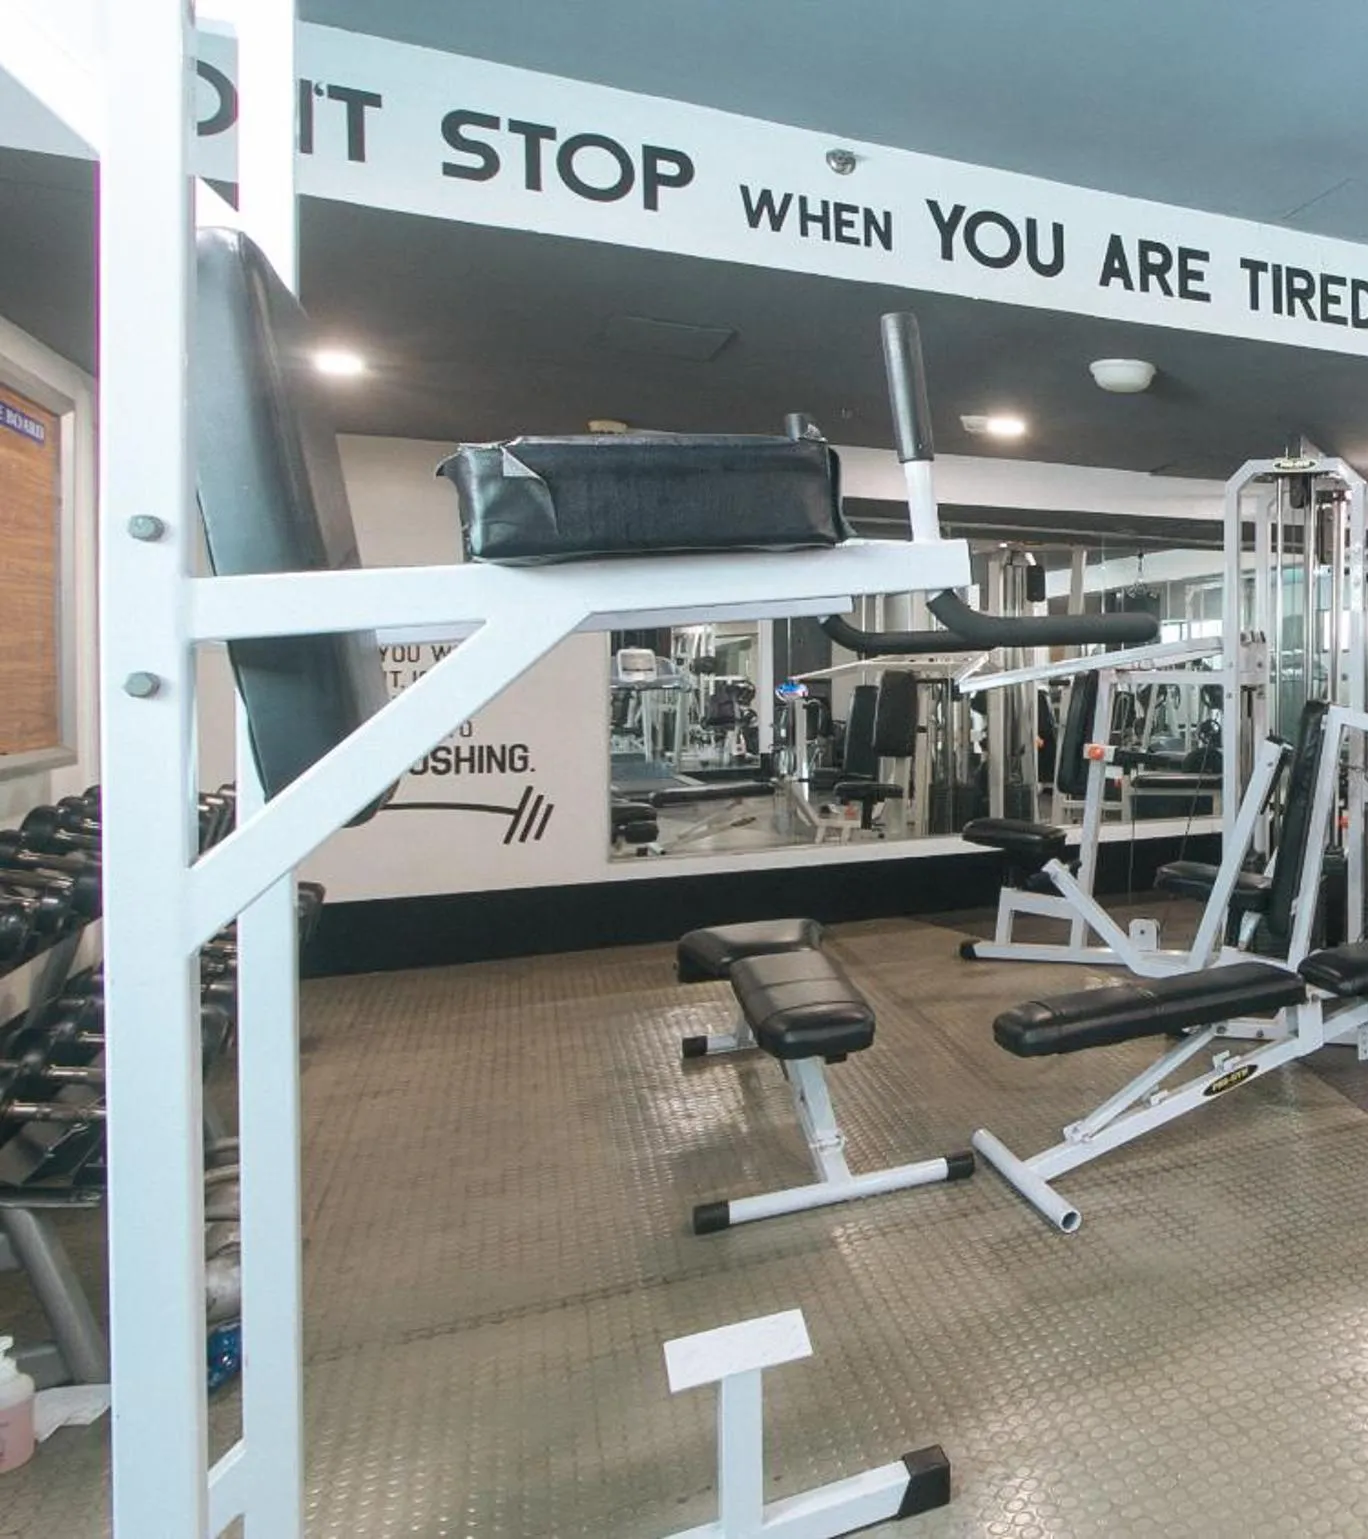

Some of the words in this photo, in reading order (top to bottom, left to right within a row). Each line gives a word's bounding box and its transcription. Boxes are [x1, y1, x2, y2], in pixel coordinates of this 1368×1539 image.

[440, 108, 696, 212] STOP
[739, 183, 893, 252] WHEN
[925, 198, 1065, 278] YOU
[1098, 233, 1212, 303] ARE
[380, 645, 420, 663] YOU
[408, 743, 536, 776] USHING.
